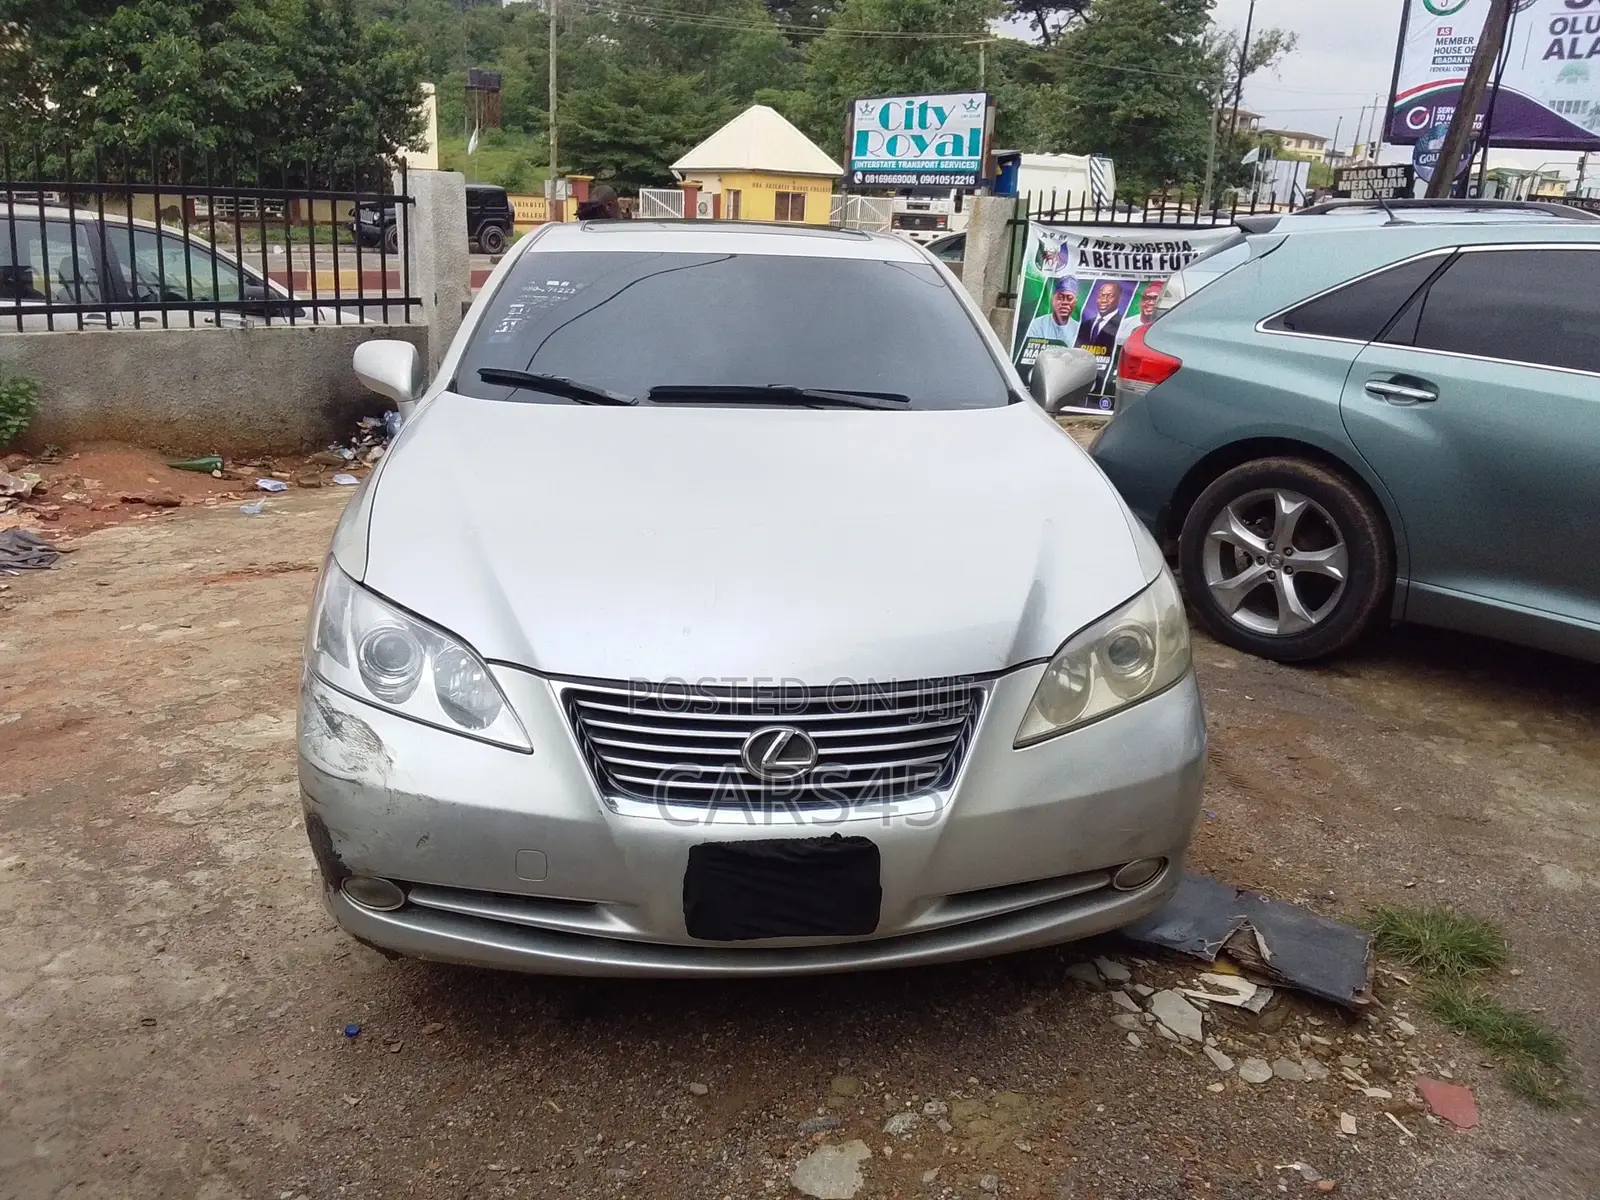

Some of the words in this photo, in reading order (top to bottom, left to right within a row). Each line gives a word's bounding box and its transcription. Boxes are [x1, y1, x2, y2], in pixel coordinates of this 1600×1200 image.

[1435, 37, 1474, 45] MEMBER
[1434, 46, 1462, 55] HOUSE
[1464, 46, 1477, 54] OF
[1435, 56, 1463, 64] IBADAN
[878, 100, 956, 131] City
[855, 128, 981, 158] Royal
[854, 161, 896, 169] (INTERSTATE
[898, 161, 939, 169] TRANSPORT
[940, 161, 978, 170] SERVICES)
[1387, 168, 1405, 178] DE
[920, 174, 975, 185] 09010512216
[1077, 237, 1089, 248] A
[1093, 239, 1126, 251] NEW
[1078, 250, 1090, 267] A
[1093, 251, 1153, 270] BETTER
[1160, 252, 1200, 270] FUT
